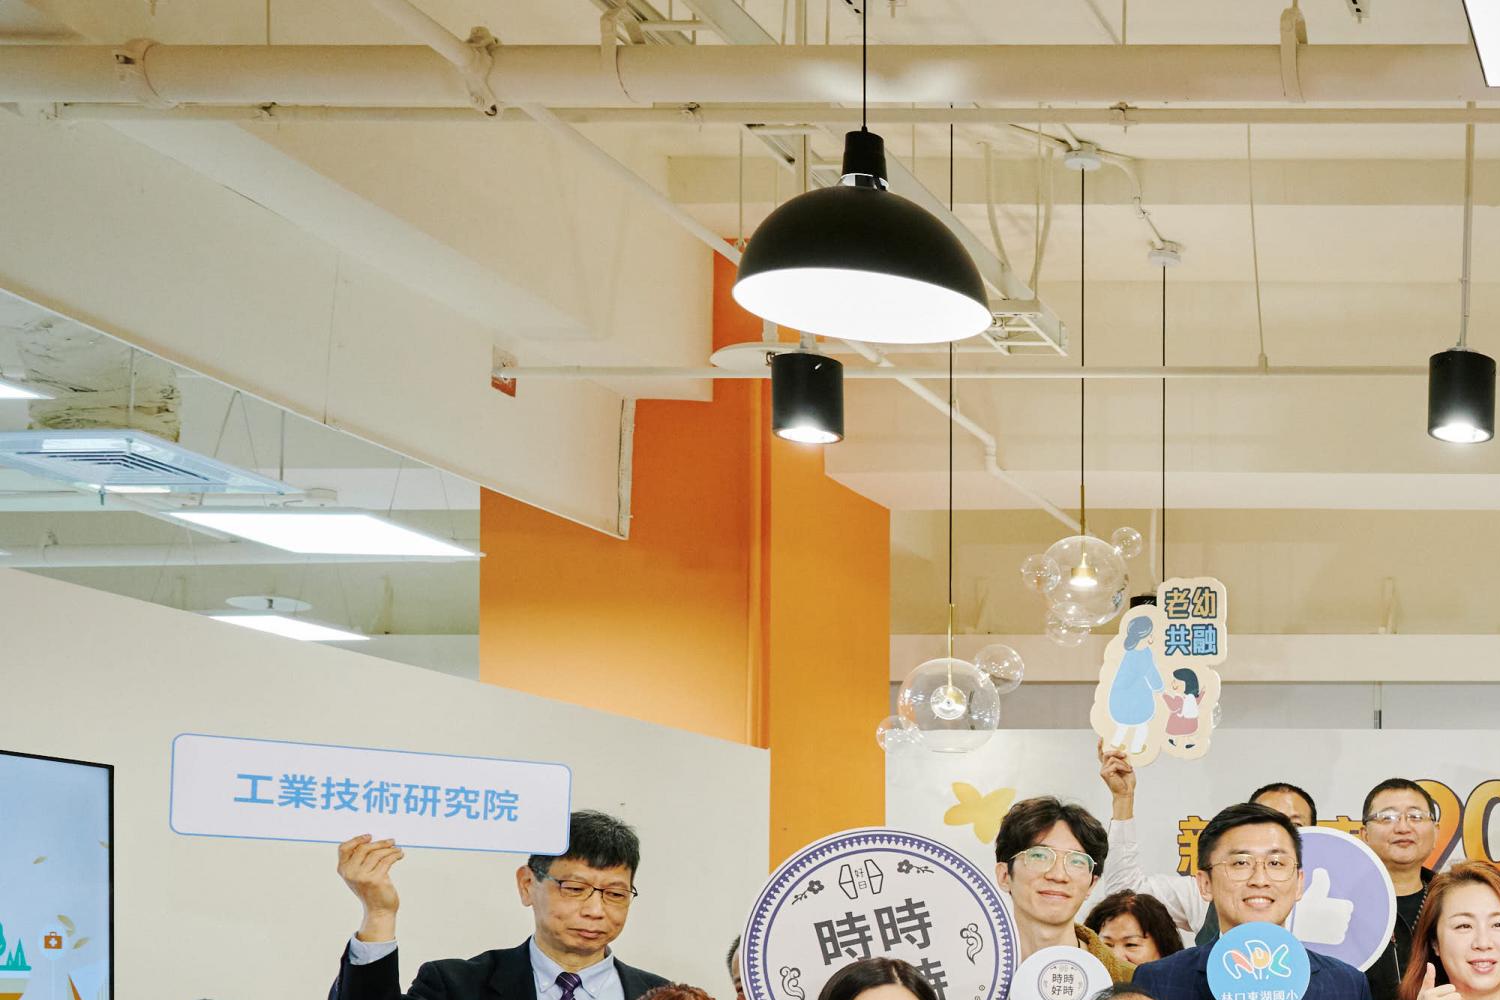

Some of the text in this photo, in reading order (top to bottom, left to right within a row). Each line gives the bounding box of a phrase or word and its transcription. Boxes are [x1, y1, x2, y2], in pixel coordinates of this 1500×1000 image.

[1165, 586, 1218, 619] 老幼
[1165, 623, 1218, 656] 共融
[233, 772, 519, 823] 工業技術研究院
